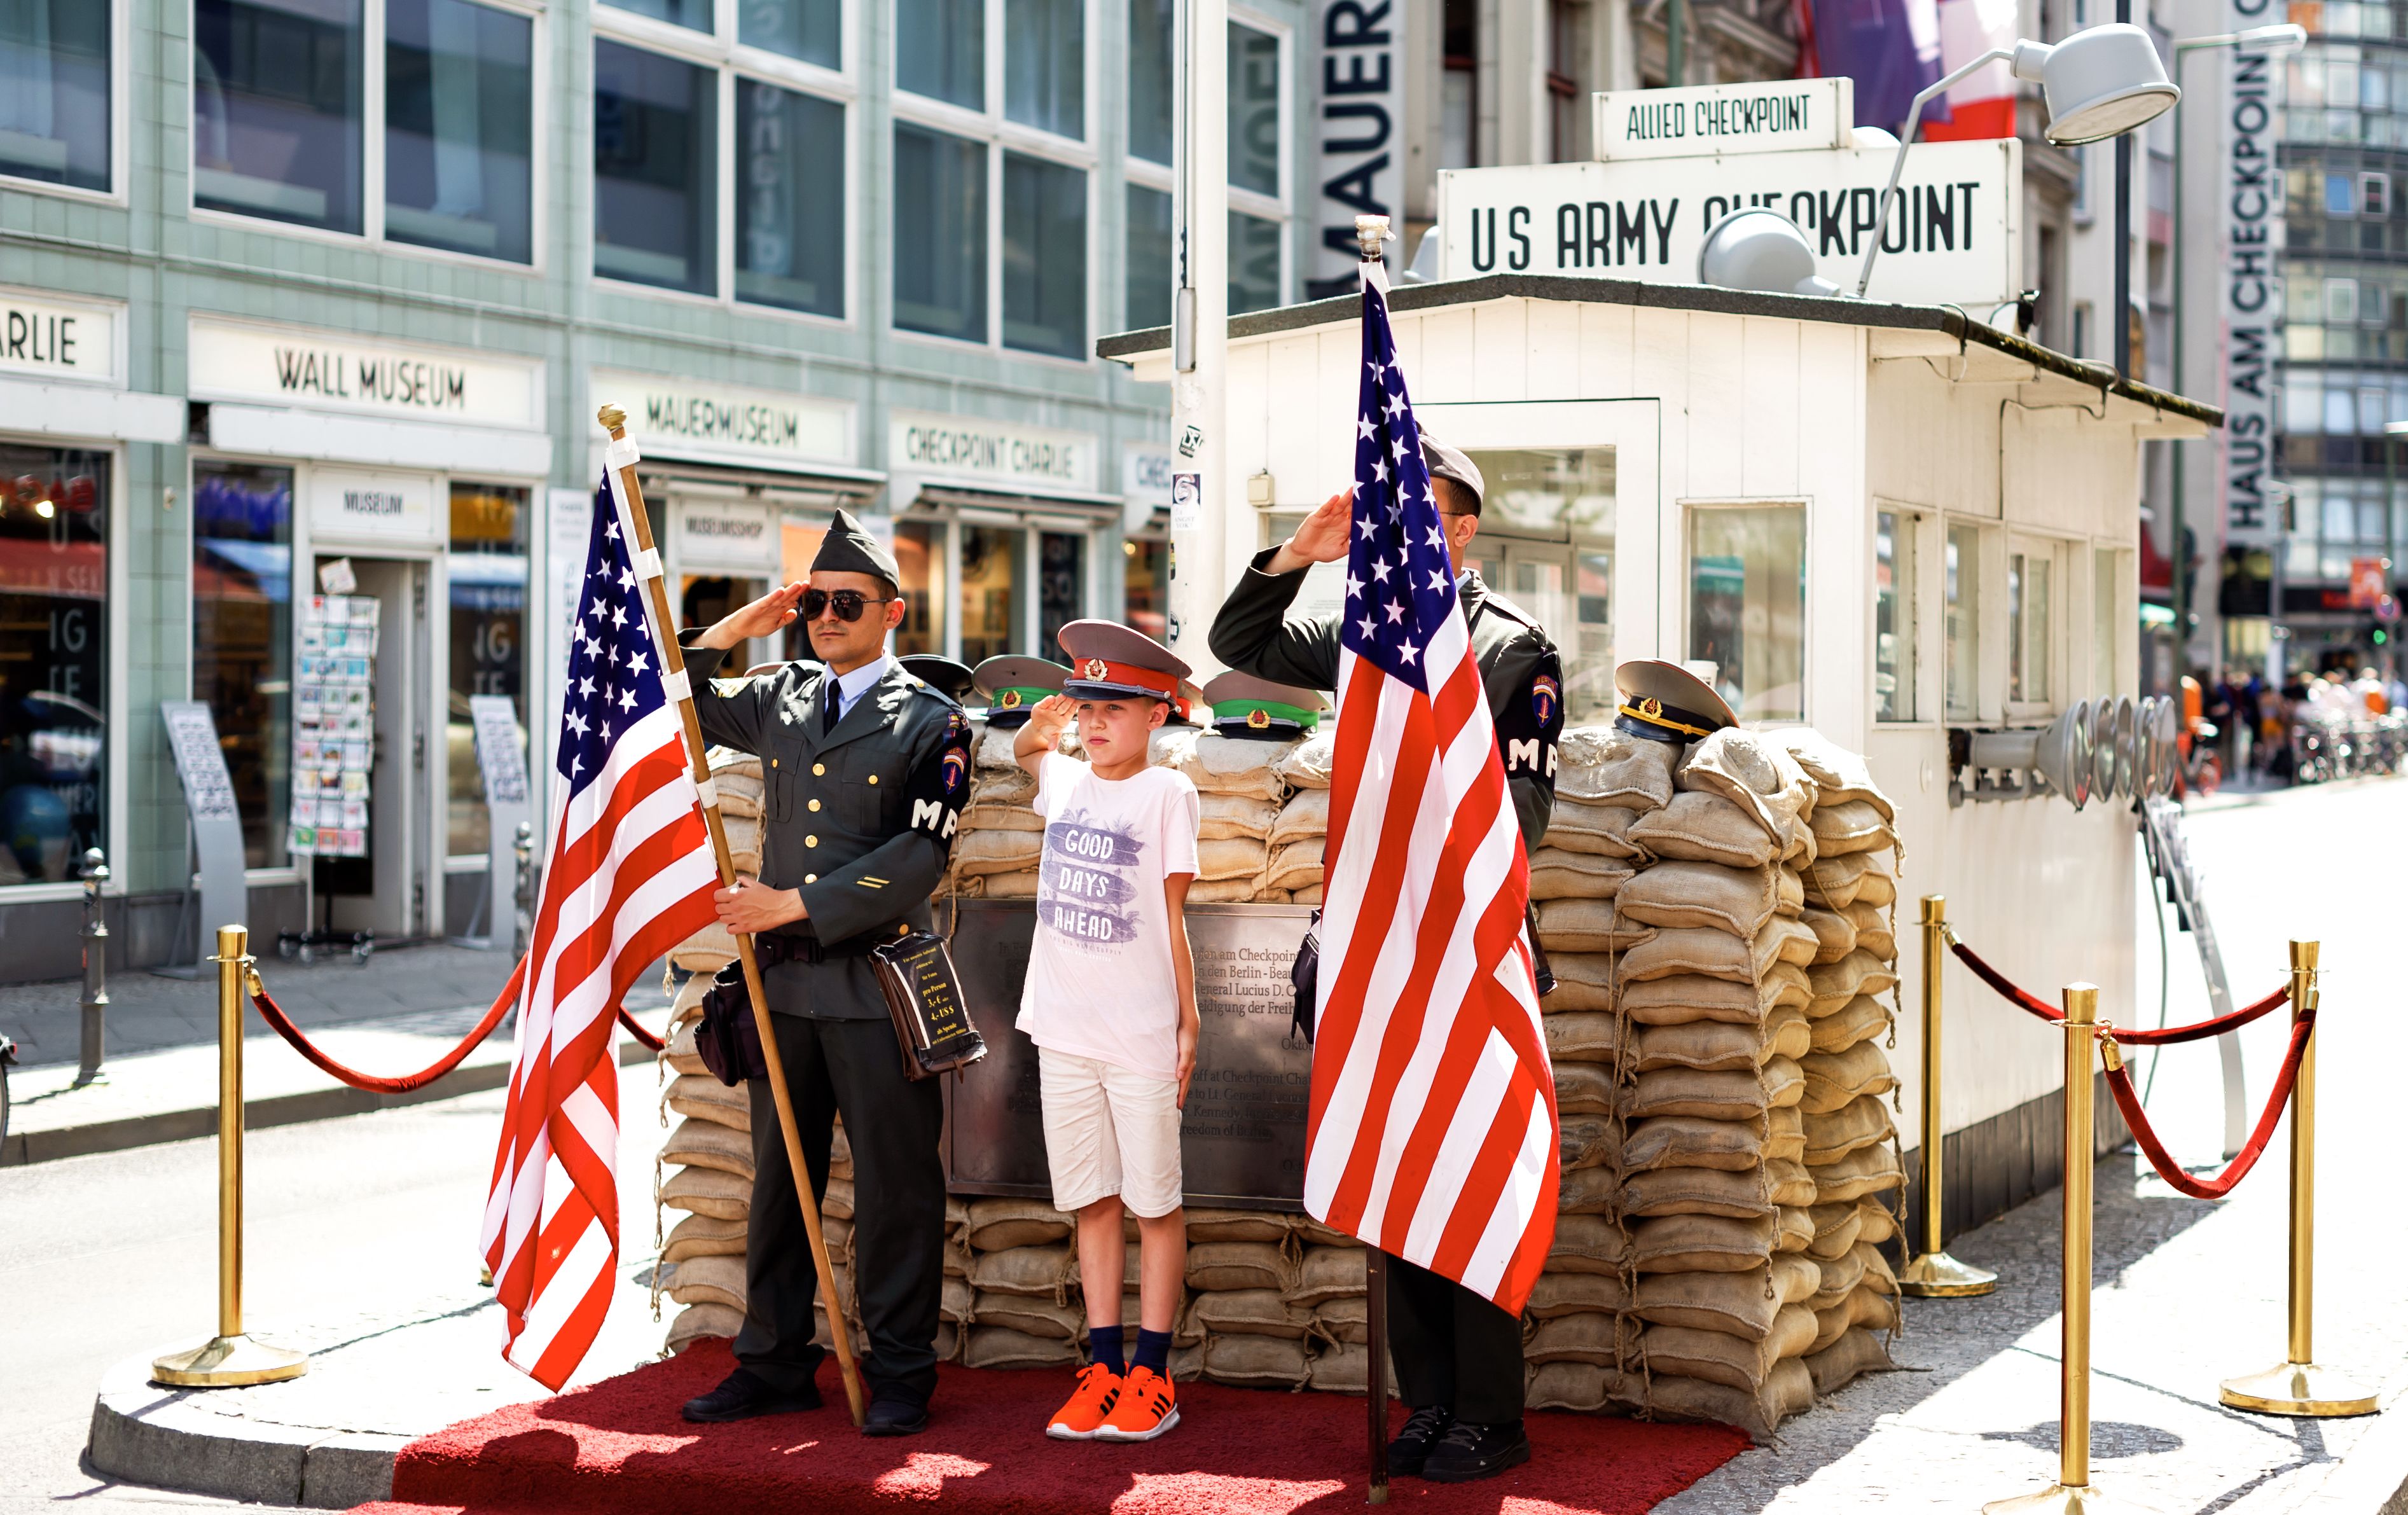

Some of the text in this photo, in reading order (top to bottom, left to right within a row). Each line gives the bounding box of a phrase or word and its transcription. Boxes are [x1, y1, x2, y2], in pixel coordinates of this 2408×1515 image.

[1626, 93, 1811, 141] ALLIED CHECKPOINT
[1557, 197, 1680, 268] ARMY
[1703, 181, 1981, 256] CCKPOINT
[2231, 326, 2267, 398] AM
[275, 348, 465, 409] WALL MUSEUM
[646, 394, 799, 446] MAUERMUSEUM
[907, 425, 1072, 478] CHECKPOINT CHARLIE
[2229, 413, 2266, 530] HAUS
[344, 490, 403, 515] MUSEUM
[686, 516, 764, 539] MUSEUMSSHOP
[1535, 676, 1556, 691] BERLIN
[1508, 738, 1558, 778] MP
[911, 798, 958, 840] MP
[1065, 829, 1114, 860] GOOD
[1058, 867, 1110, 898] DAYS
[1054, 906, 1112, 941] AHEAD
[1205, 965, 1226, 978] den
[1229, 965, 1262, 978] Berlin
[1219, 951, 1236, 960] am
[1238, 948, 1299, 965] Checkpoin
[922, 983, 947, 997] pro Person
[1235, 983, 1270, 996] Lucius
[1272, 984, 1284, 997] D.
[1198, 1000, 1246, 1017] eidigung
[1248, 1000, 1265, 1014] der
[1193, 1069, 1208, 1081] off
[1210, 1070, 1220, 1082] at
[1222, 1069, 1284, 1086] Checkpoint
[1181, 1122, 1221, 1136] reedom
[1223, 1123, 1234, 1136] of
